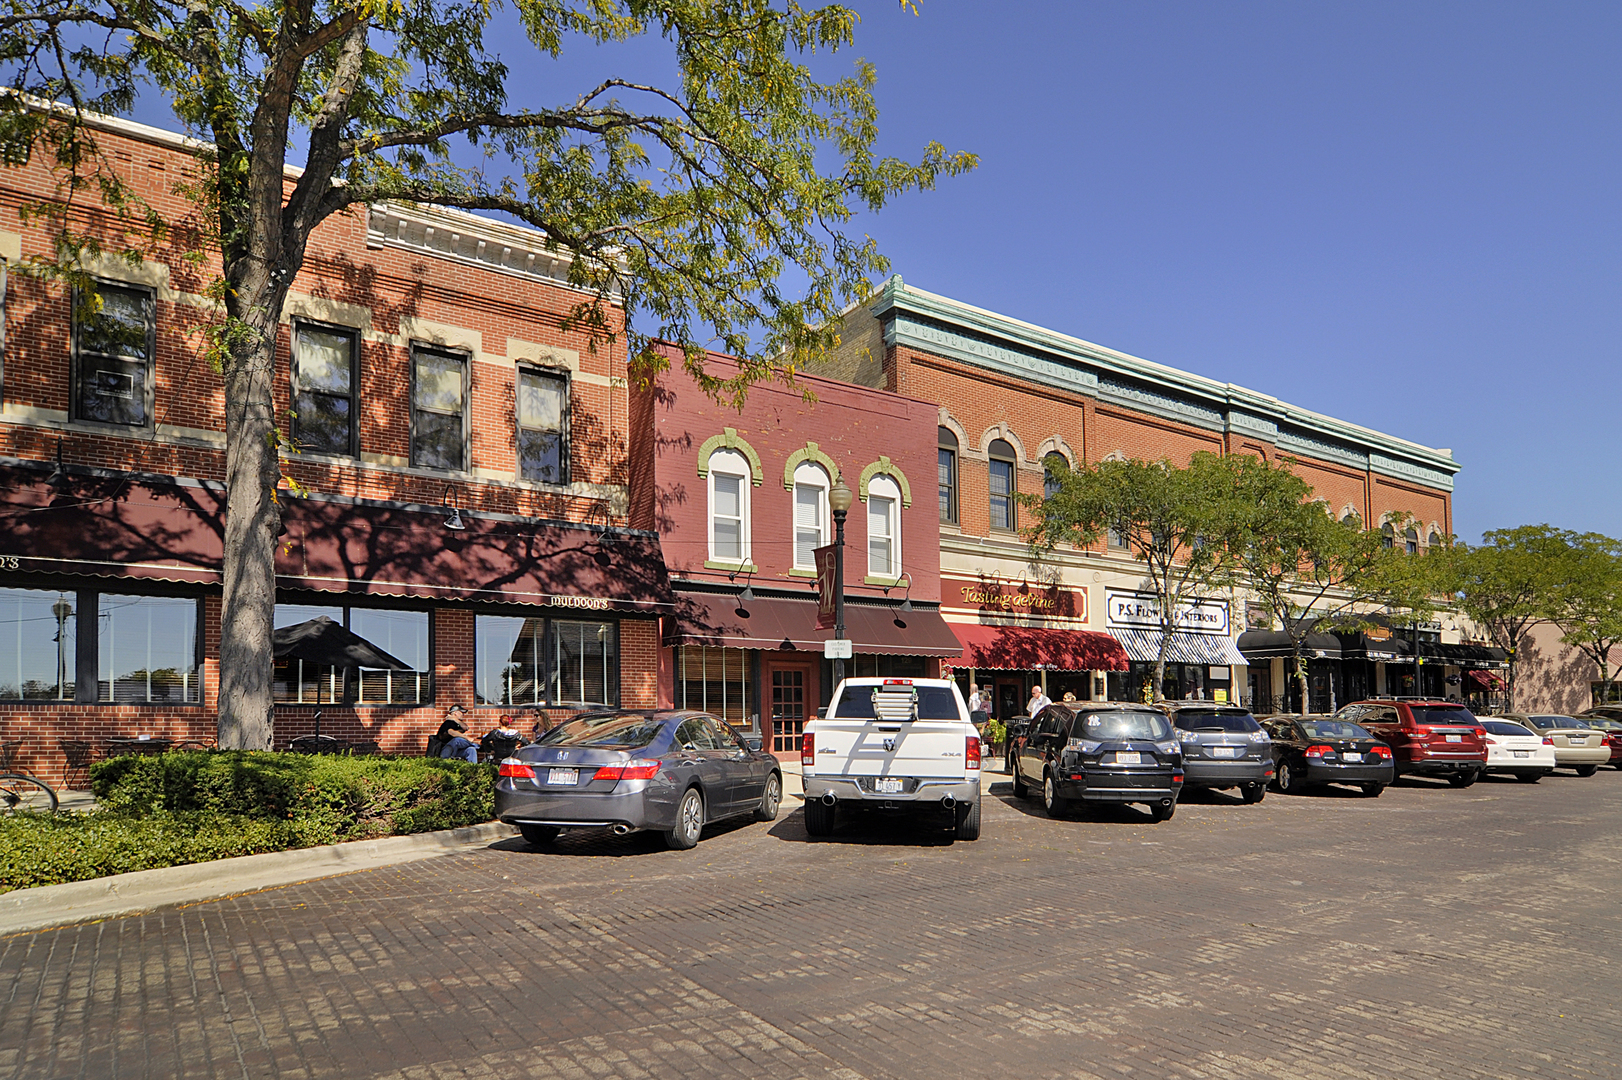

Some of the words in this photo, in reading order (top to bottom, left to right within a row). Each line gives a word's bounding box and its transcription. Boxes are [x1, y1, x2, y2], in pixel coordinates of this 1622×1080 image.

[551, 596, 608, 609] MULDOON'S
[961, 586, 1012, 610] Tasting
[1118, 603, 1134, 616] P.S.
